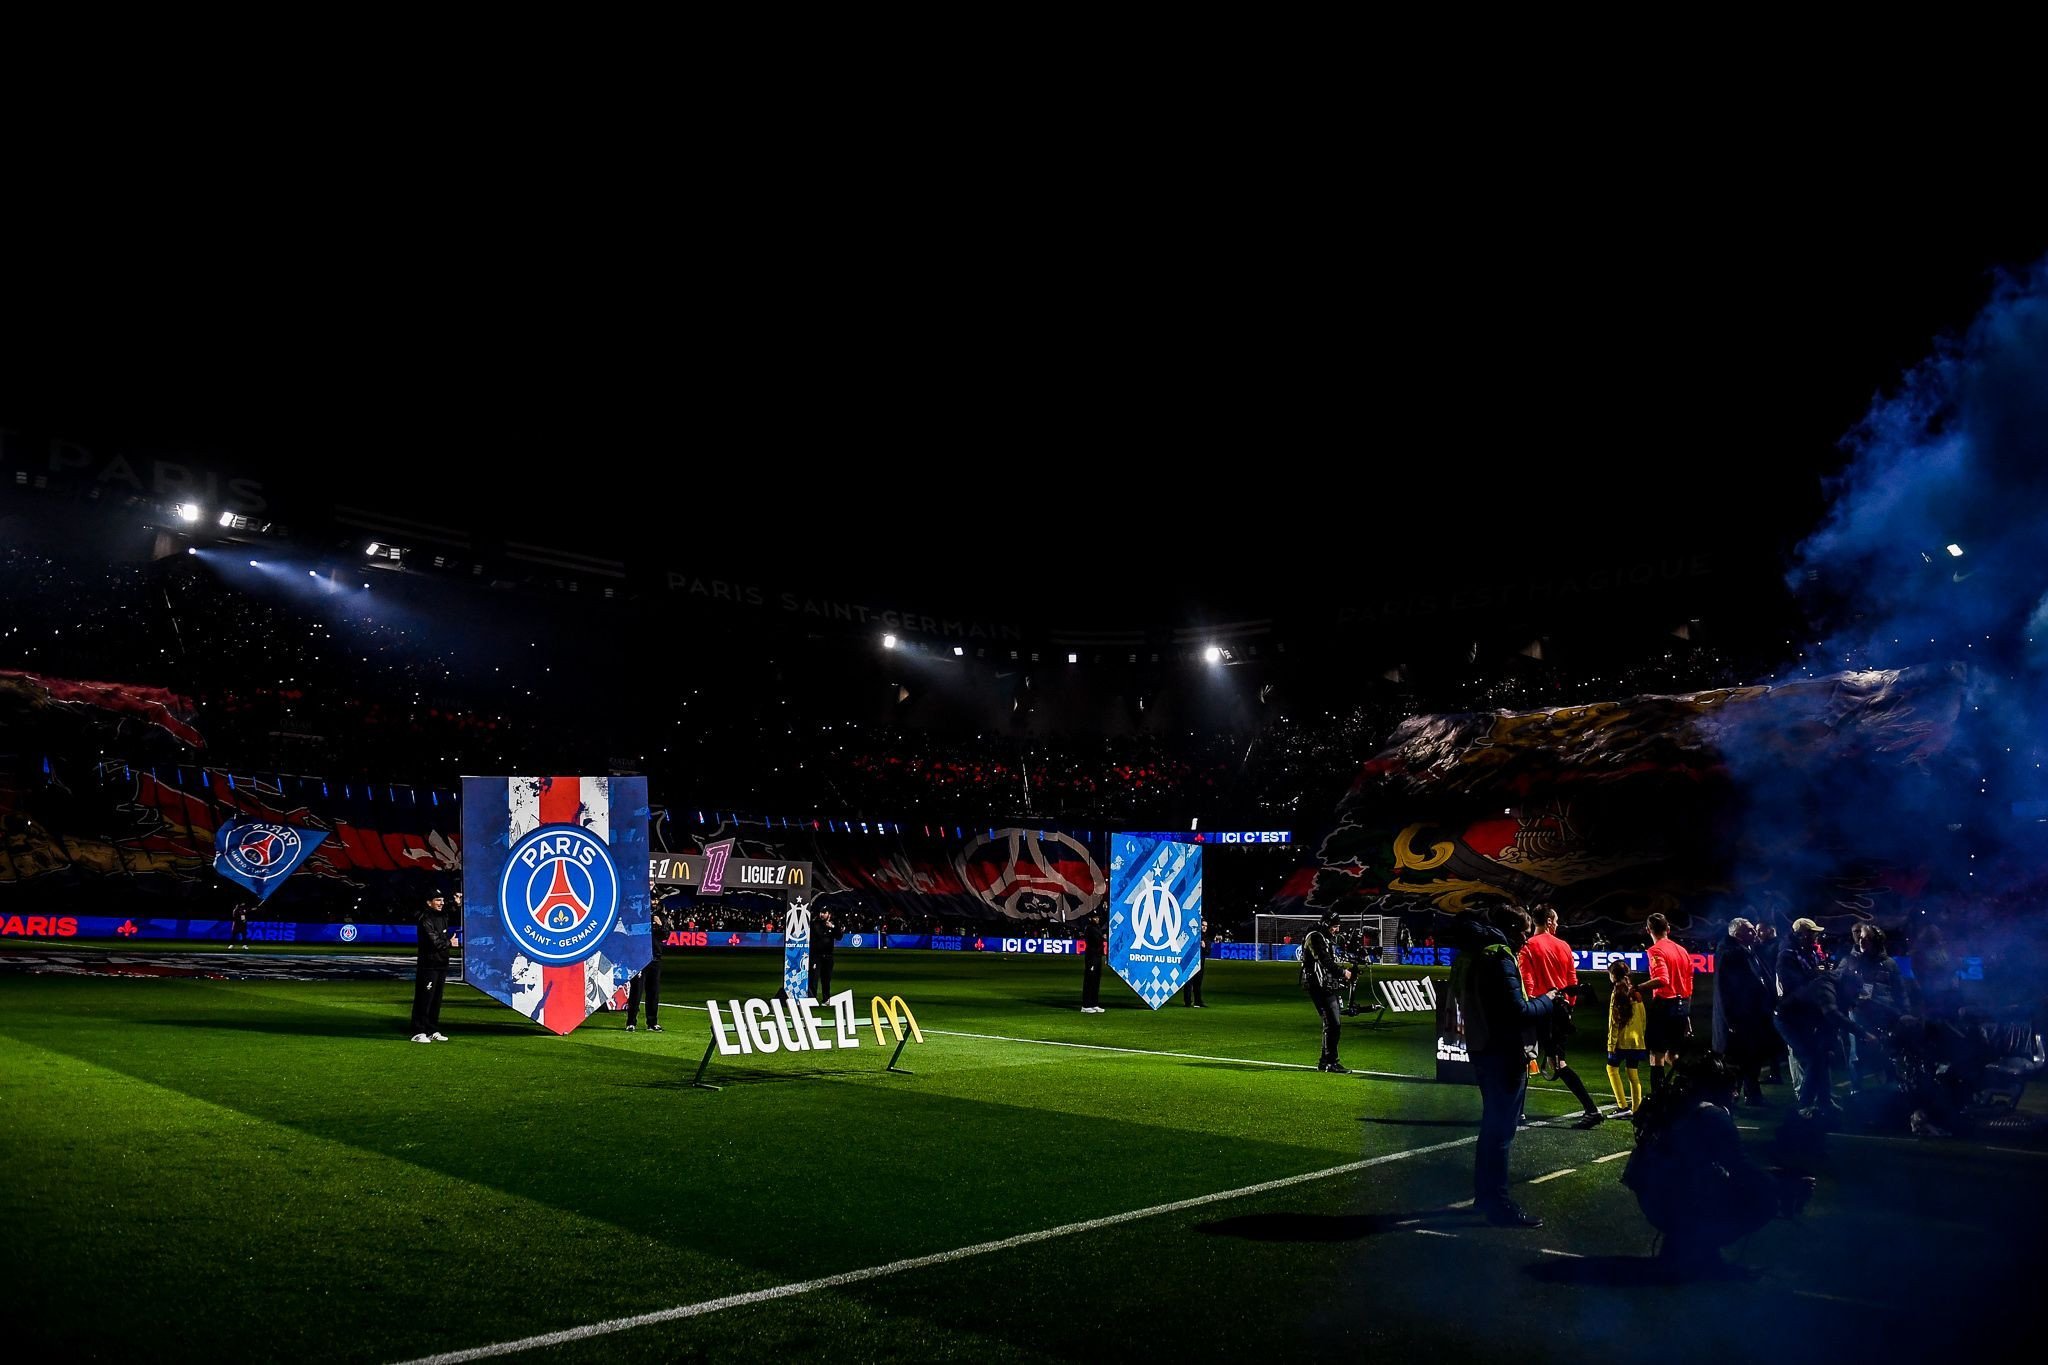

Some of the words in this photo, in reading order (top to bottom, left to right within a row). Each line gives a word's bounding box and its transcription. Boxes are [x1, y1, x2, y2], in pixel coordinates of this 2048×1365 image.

[666, 570, 765, 606] PARIS
[1222, 832, 1240, 843] ICI
[1244, 831, 1288, 843] C'EST
[521, 837, 597, 869] PARIS
[666, 931, 708, 946] ARIS
[1002, 938, 1021, 953] ICI
[1025, 938, 1073, 954] C'EST
[1129, 953, 1154, 963] DROIT
[1154, 954, 1166, 963] AU
[1166, 955, 1182, 964] BUT
